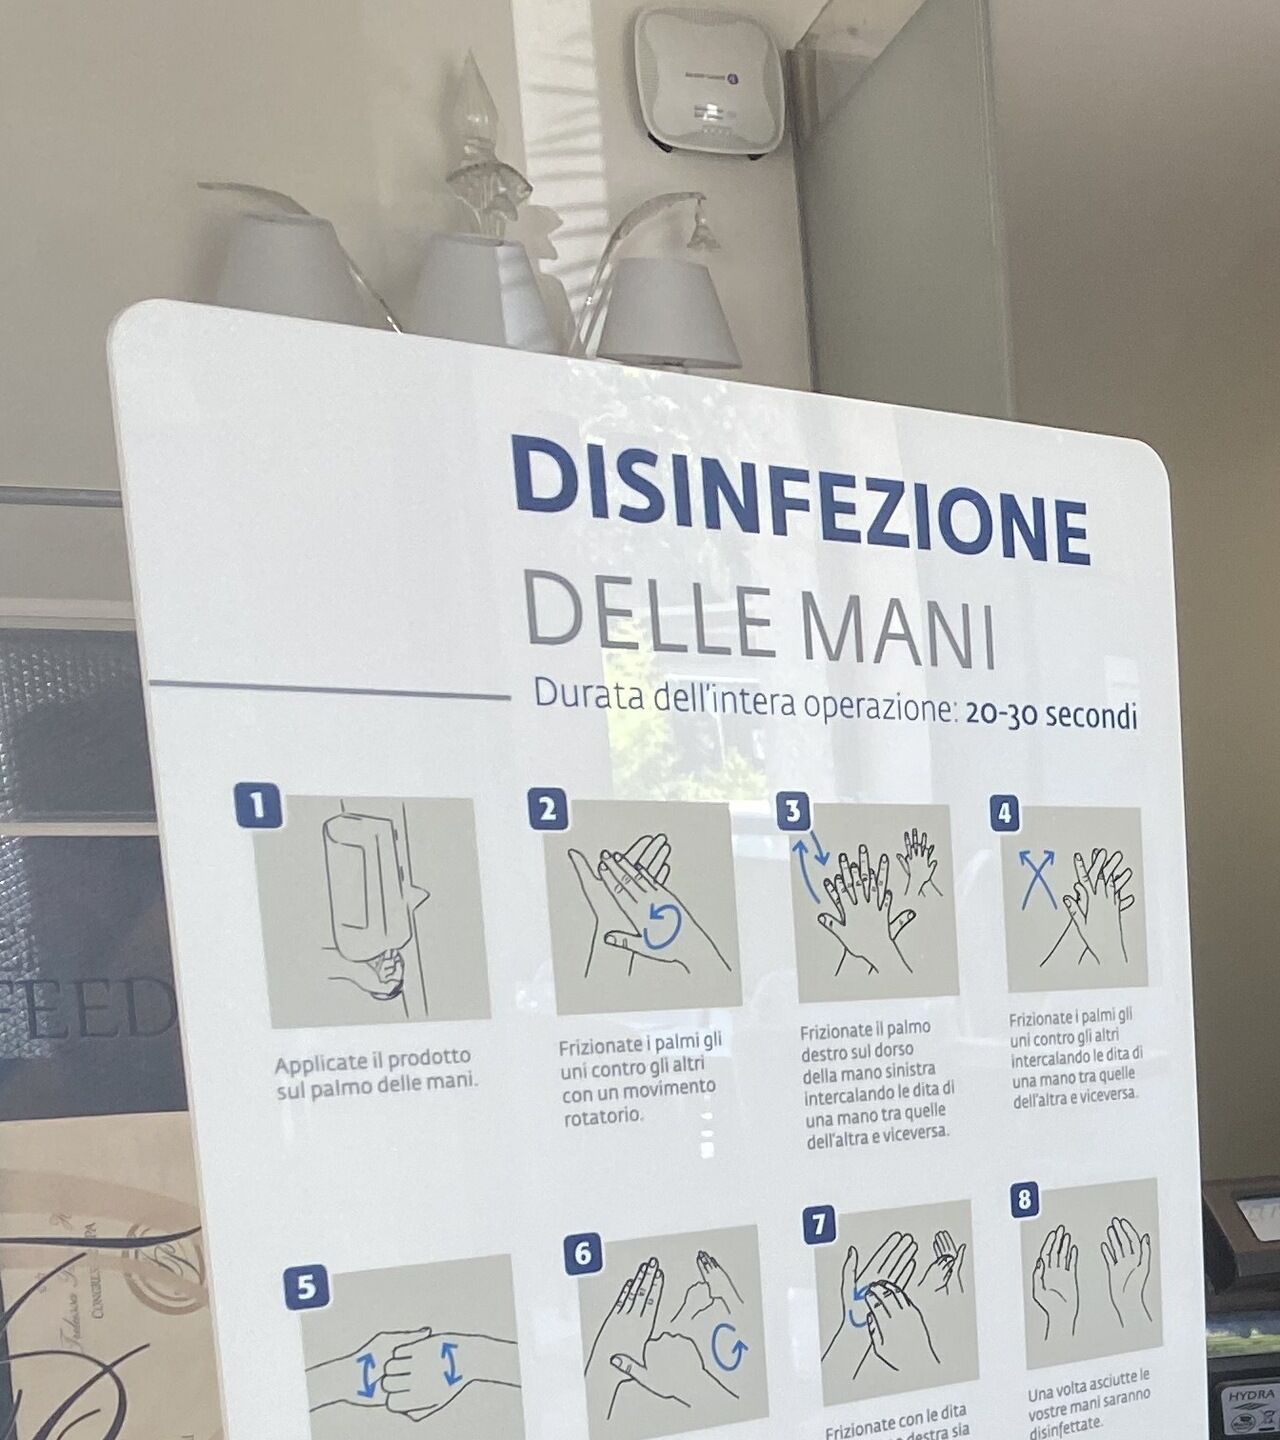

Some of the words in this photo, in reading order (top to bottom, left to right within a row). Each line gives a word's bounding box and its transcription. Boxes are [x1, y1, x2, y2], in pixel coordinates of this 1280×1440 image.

[511, 434, 1091, 566] DISINFEZIONE
[524, 568, 776, 658] DELLE
[801, 590, 995, 671] MANI
[535, 676, 644, 712] Durata
[654, 680, 796, 717] dell'intera
[804, 691, 959, 724] operazione:
[966, 702, 1038, 730] 20-30
[1045, 702, 1137, 730] secondi
[251, 792, 263, 817] 1
[540, 797, 556, 820] 2
[786, 800, 800, 822] 3
[999, 803, 1011, 823] 4
[1009, 1011, 1072, 1027] Frizionate
[1082, 1007, 1115, 1024] palmi
[1119, 1006, 1132, 1024] gli
[801, 1024, 872, 1040] Frizionate
[876, 1021, 883, 1036] il
[888, 1019, 931, 1038] palmo
[1010, 1032, 1030, 1048] uni
[1034, 1032, 1075, 1046] contro
[1078, 1029, 1092, 1047] gli
[1095, 1027, 1119, 1042] altri
[559, 1037, 643, 1056] Frizionate
[647, 1035, 650, 1050] i
[655, 1032, 699, 1053] palmi
[704, 1031, 722, 1051] gli
[802, 1048, 848, 1062] destro
[851, 1044, 871, 1059] sul
[875, 1042, 914, 1058] dorso
[275, 1054, 368, 1077] Applicate
[373, 1051, 382, 1068] il
[389, 1049, 471, 1071] prodotto
[561, 1063, 587, 1080] uni
[592, 1062, 646, 1078] contro
[650, 1058, 669, 1078] gli
[673, 1055, 704, 1072] altri
[1011, 1051, 1090, 1068] intercalando
[1094, 1049, 1103, 1062] le
[1107, 1047, 1130, 1061] dita
[1133, 1045, 1143, 1059] di
[803, 1068, 837, 1084] della
[841, 1067, 882, 1081] mano
[886, 1062, 936, 1078] sinistra
[1012, 1075, 1036, 1088] una
[1040, 1072, 1076, 1086] mano
[1079, 1071, 1096, 1083] tra
[1100, 1066, 1135, 1084] quelle
[277, 1081, 305, 1100] sul
[311, 1079, 373, 1102] palmo
[377, 1075, 422, 1093] delle
[427, 1071, 478, 1090] mani.
[563, 1089, 593, 1103] con
[598, 1087, 619, 1101] un
[623, 1079, 716, 1099] movimento
[805, 1085, 895, 1106] intercalando
[898, 1084, 910, 1098] le
[913, 1082, 939, 1097] dita
[943, 1079, 955, 1094] di
[1014, 1093, 1067, 1109] dell'altra
[1071, 1092, 1078, 1104] e
[1080, 1087, 1139, 1103] viceversa.
[565, 1106, 644, 1127] rotatorio.
[806, 1114, 833, 1128] una
[837, 1111, 878, 1125] mano
[882, 1108, 901, 1121] tra
[905, 1102, 946, 1122] quelle
[807, 1132, 868, 1150] dell'altra
[872, 1131, 880, 1143] e
[883, 1125, 950, 1142] viceversa.
[1019, 1190, 1031, 1209] 8
[813, 1214, 825, 1234] 7
[575, 1242, 591, 1264] 6
[299, 1275, 315, 1299] 5
[1028, 1388, 1053, 1402] Una
[1056, 1381, 1087, 1397] volta
[1090, 1372, 1137, 1390] asciutte
[1140, 1368, 1150, 1381] le
[1229, 1389, 1275, 1401] HYDRA
[1029, 1405, 1067, 1422] vostre
[1070, 1395, 1100, 1414] mani
[1104, 1388, 1151, 1408] saranno
[1030, 1417, 1104, 1440] disinfettate.
